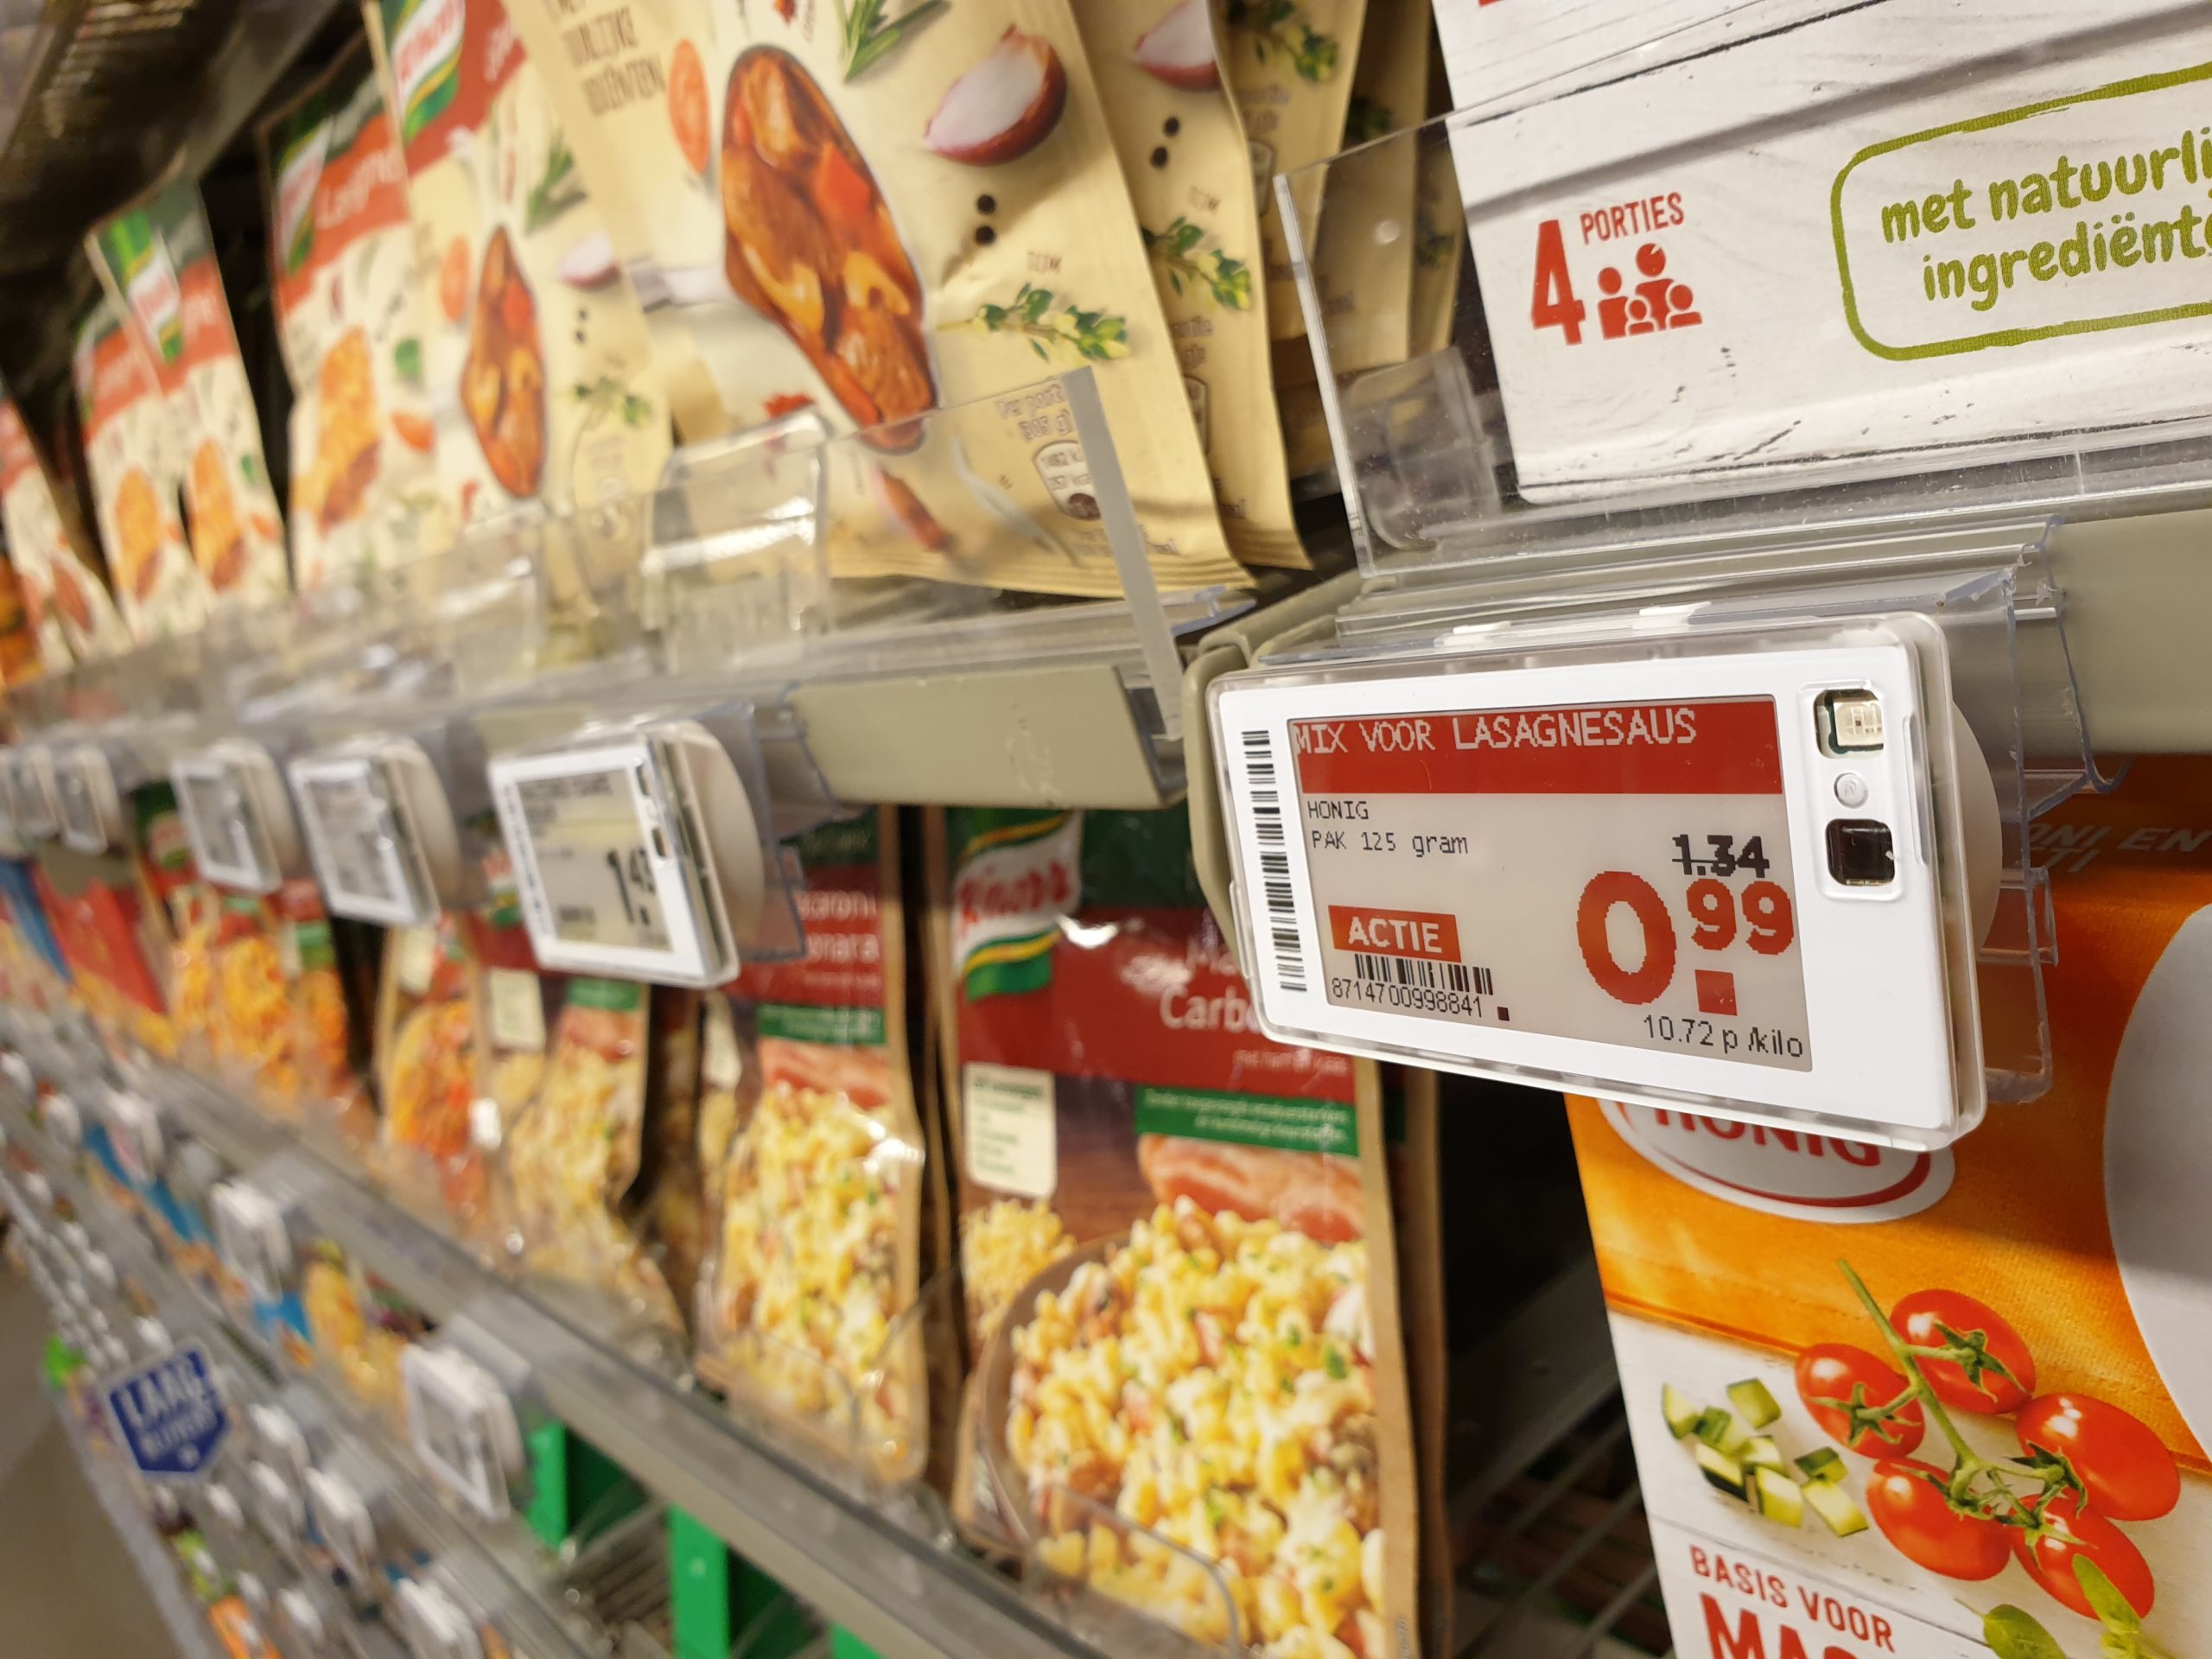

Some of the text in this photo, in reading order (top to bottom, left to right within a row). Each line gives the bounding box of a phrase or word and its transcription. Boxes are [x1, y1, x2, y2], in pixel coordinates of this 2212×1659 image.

[1880, 126, 2212, 243] met natuurli
[1579, 191, 1685, 245] PORTIES
[1530, 219, 1586, 346] 4
[1295, 708, 1697, 753] MIX VOOR LASAGNESAUS
[1307, 800, 1369, 820] HONIG
[1311, 830, 1469, 858] PAK 125 gram
[1348, 916, 1443, 954] ACTIE
[1332, 977, 1483, 1018] 8714700998841
[1643, 1014, 1803, 1058] 10.72 p /kilo
[1689, 1543, 1896, 1654] BASIS VOOR
